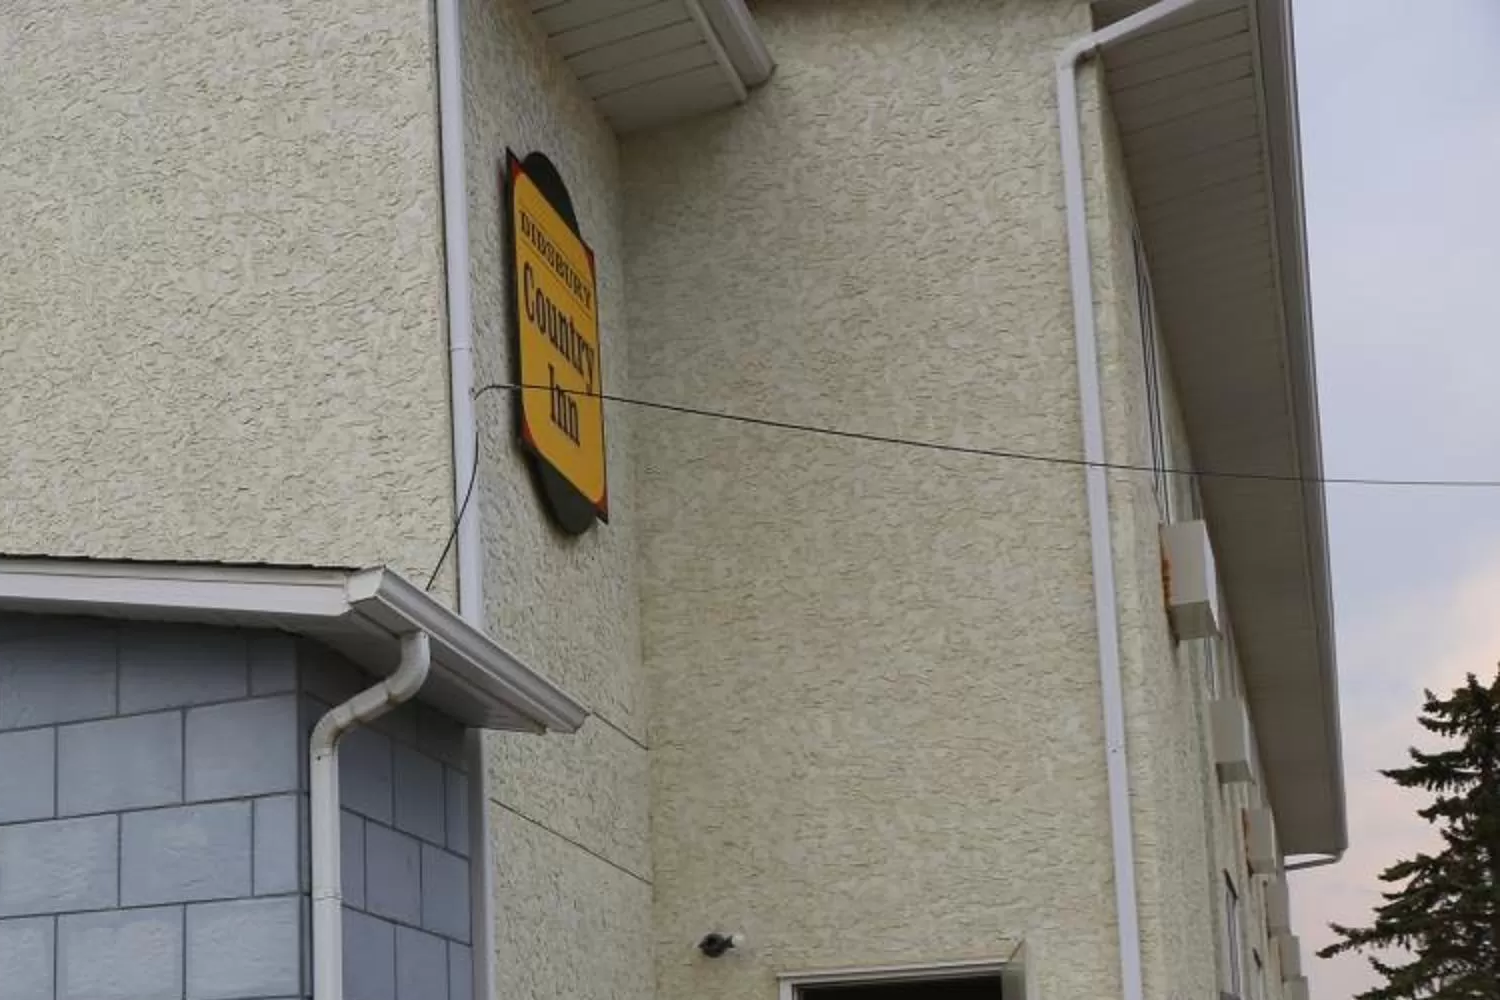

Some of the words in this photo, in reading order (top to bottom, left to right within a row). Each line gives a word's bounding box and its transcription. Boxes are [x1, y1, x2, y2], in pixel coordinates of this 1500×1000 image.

[519, 209, 591, 309] DIDSBURY
[523, 261, 594, 395] Country
[548, 363, 581, 447] Inn
